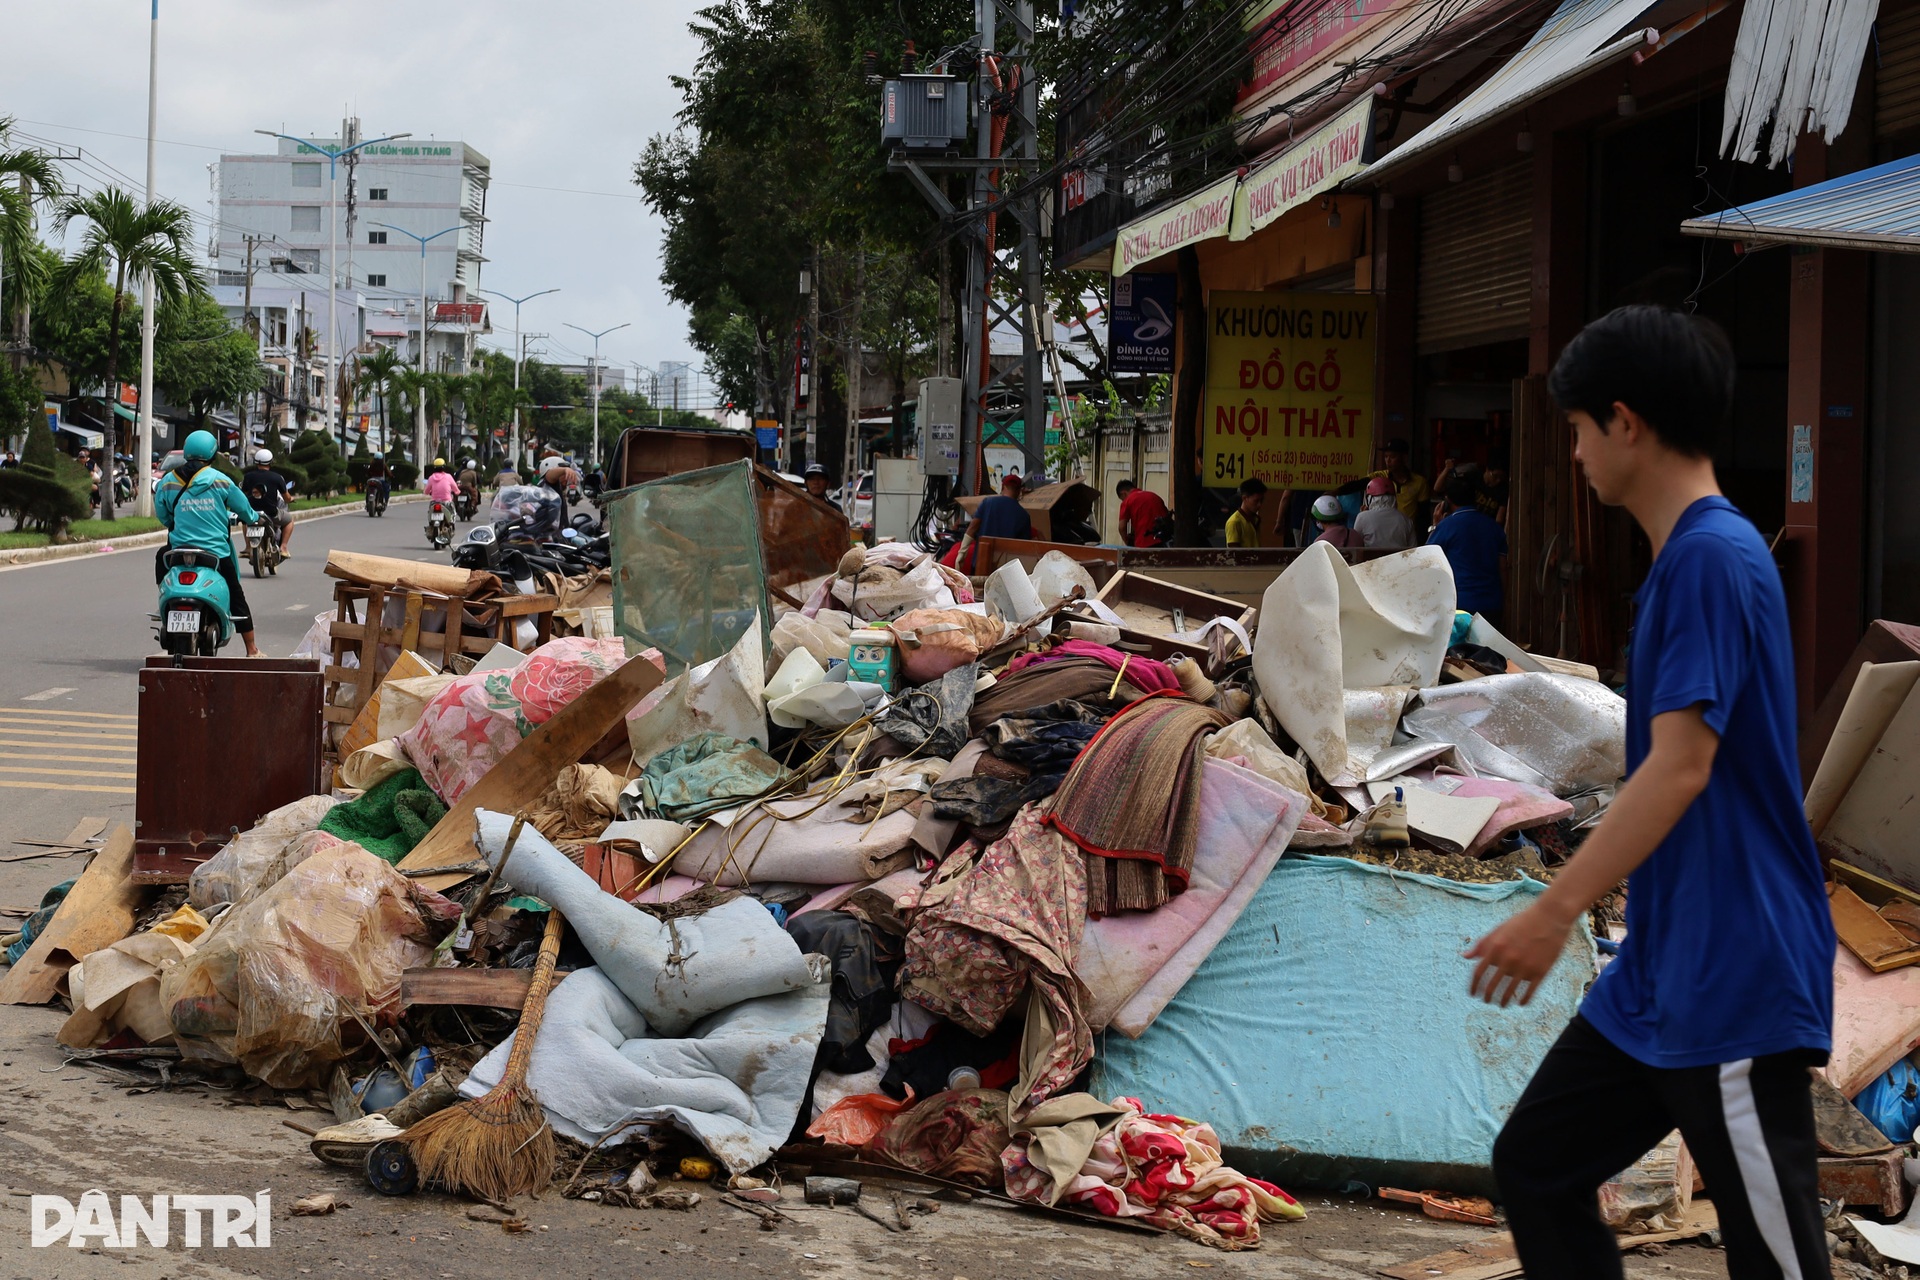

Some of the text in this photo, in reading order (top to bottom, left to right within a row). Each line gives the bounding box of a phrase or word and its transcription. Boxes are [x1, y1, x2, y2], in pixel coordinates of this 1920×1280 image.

[422, 147, 452, 156] TRANG
[1250, 122, 1360, 221] PHỤC VỤ TẬN TÌNH
[1135, 227, 1151, 260] TÍN
[1159, 208, 1187, 250] CHẤT
[1188, 195, 1229, 239] LƯỢNG
[1215, 305, 1368, 340] KHƯƠNG DUY
[1117, 343, 1170, 356] ĐỈNH CAO
[1239, 348, 1342, 392] ĐỒ GỖ
[1216, 396, 1362, 442] NỘI THẤT
[1215, 453, 1244, 479] 541
[1272, 450, 1282, 464] cũ
[1284, 451, 1298, 467] 23)
[1300, 451, 1328, 468] Đường
[1330, 452, 1352, 466] 23/10
[1274, 470, 1294, 486] Hiệp
[171, 622, 196, 632] 171.34
[173, 612, 195, 622] 50-AA
